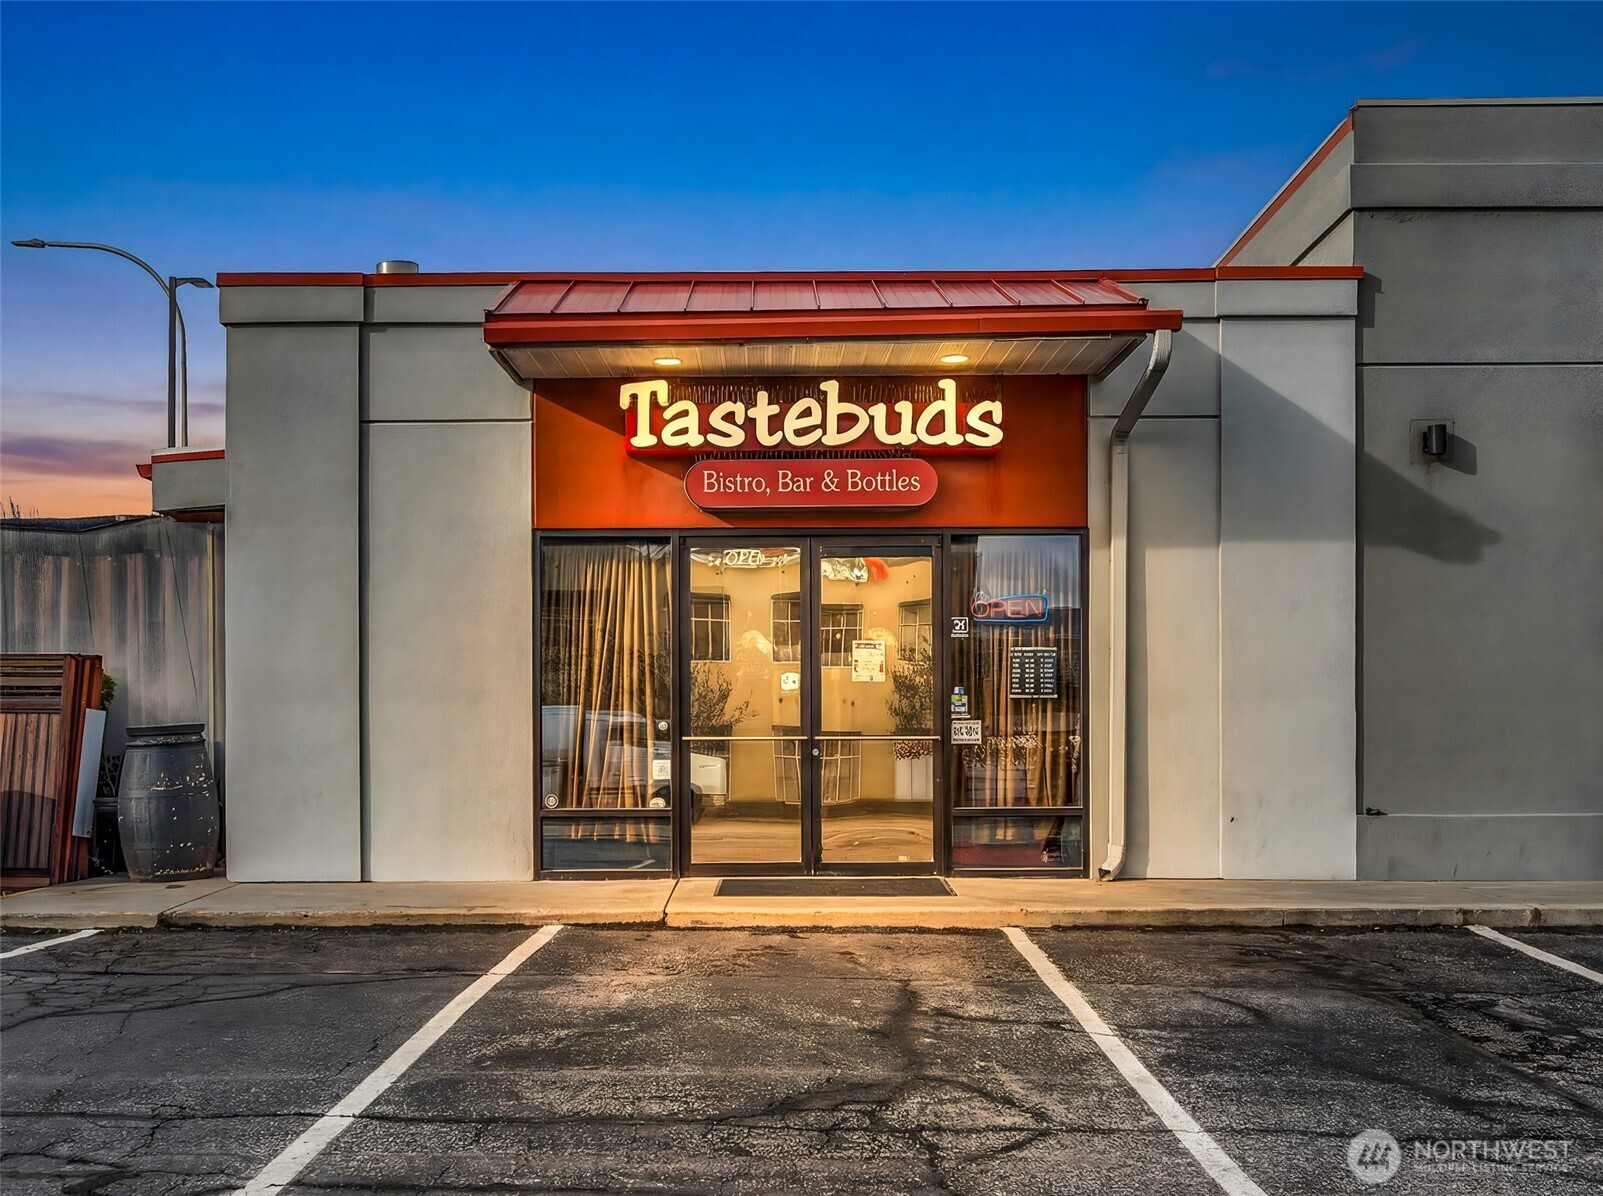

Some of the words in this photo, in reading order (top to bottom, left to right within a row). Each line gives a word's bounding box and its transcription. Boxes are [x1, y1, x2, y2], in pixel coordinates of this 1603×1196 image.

[619, 378, 1004, 448] Tastebuds
[702, 470, 771, 496] Bistro,
[777, 470, 814, 492] Bar
[821, 471, 839, 492] &
[846, 469, 921, 492] Bottles
[970, 599, 1044, 618] OPEN
